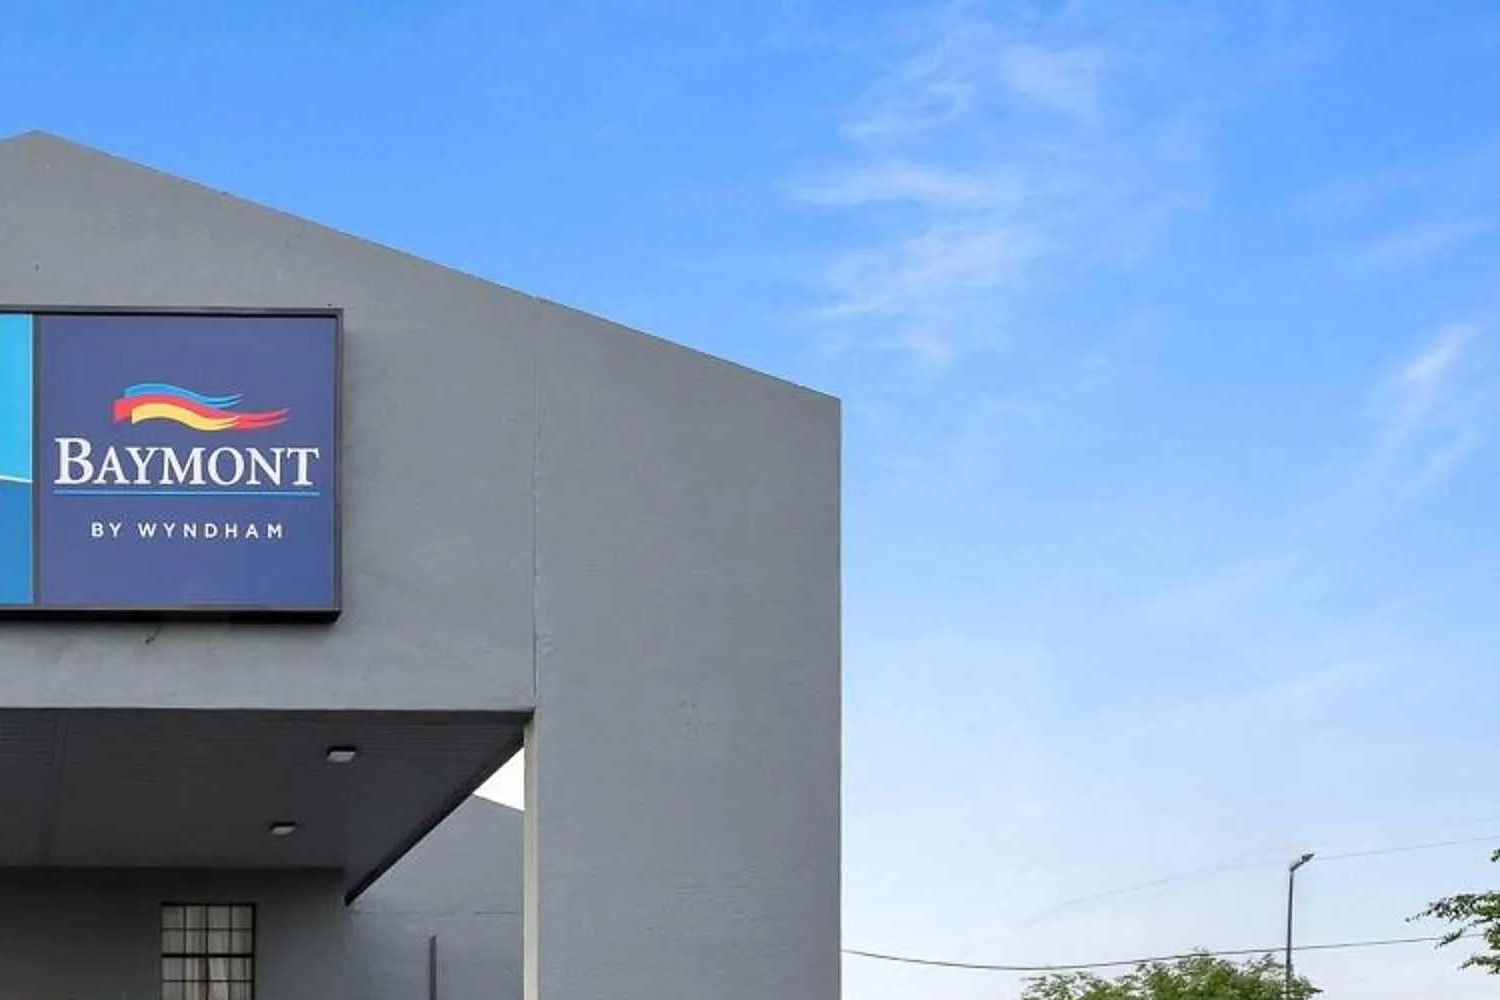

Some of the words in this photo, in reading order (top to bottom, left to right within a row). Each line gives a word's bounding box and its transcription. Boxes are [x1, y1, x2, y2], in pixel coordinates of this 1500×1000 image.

[54, 437, 320, 486] BAYMONT
[90, 522, 122, 538] BY
[138, 523, 284, 538] WYNDHAM
